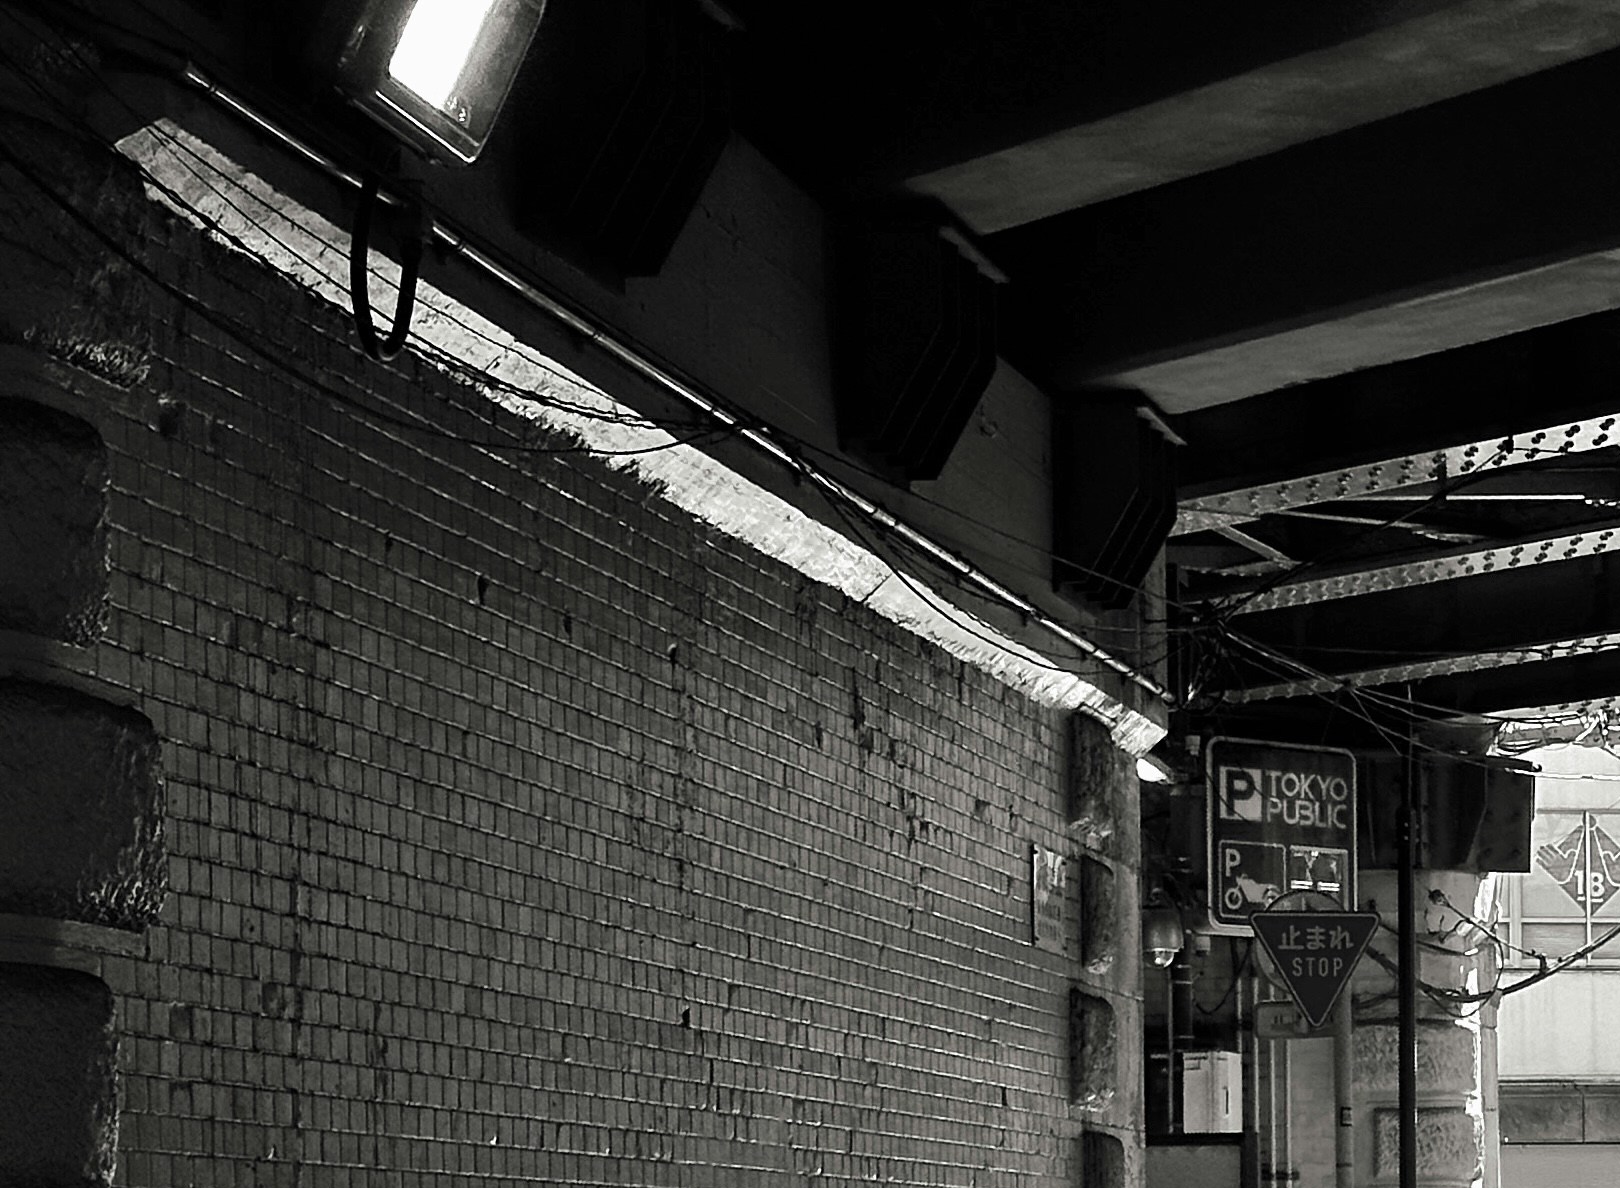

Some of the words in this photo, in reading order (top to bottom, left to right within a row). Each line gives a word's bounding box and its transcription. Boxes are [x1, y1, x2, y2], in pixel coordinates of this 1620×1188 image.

[1226, 768, 1256, 817] P
[1265, 770, 1347, 801] TOKYO
[1266, 797, 1347, 829] PUBLIC
[1226, 848, 1241, 877] P
[1278, 925, 1354, 950] 止まれ
[1292, 957, 1343, 977] STOP
